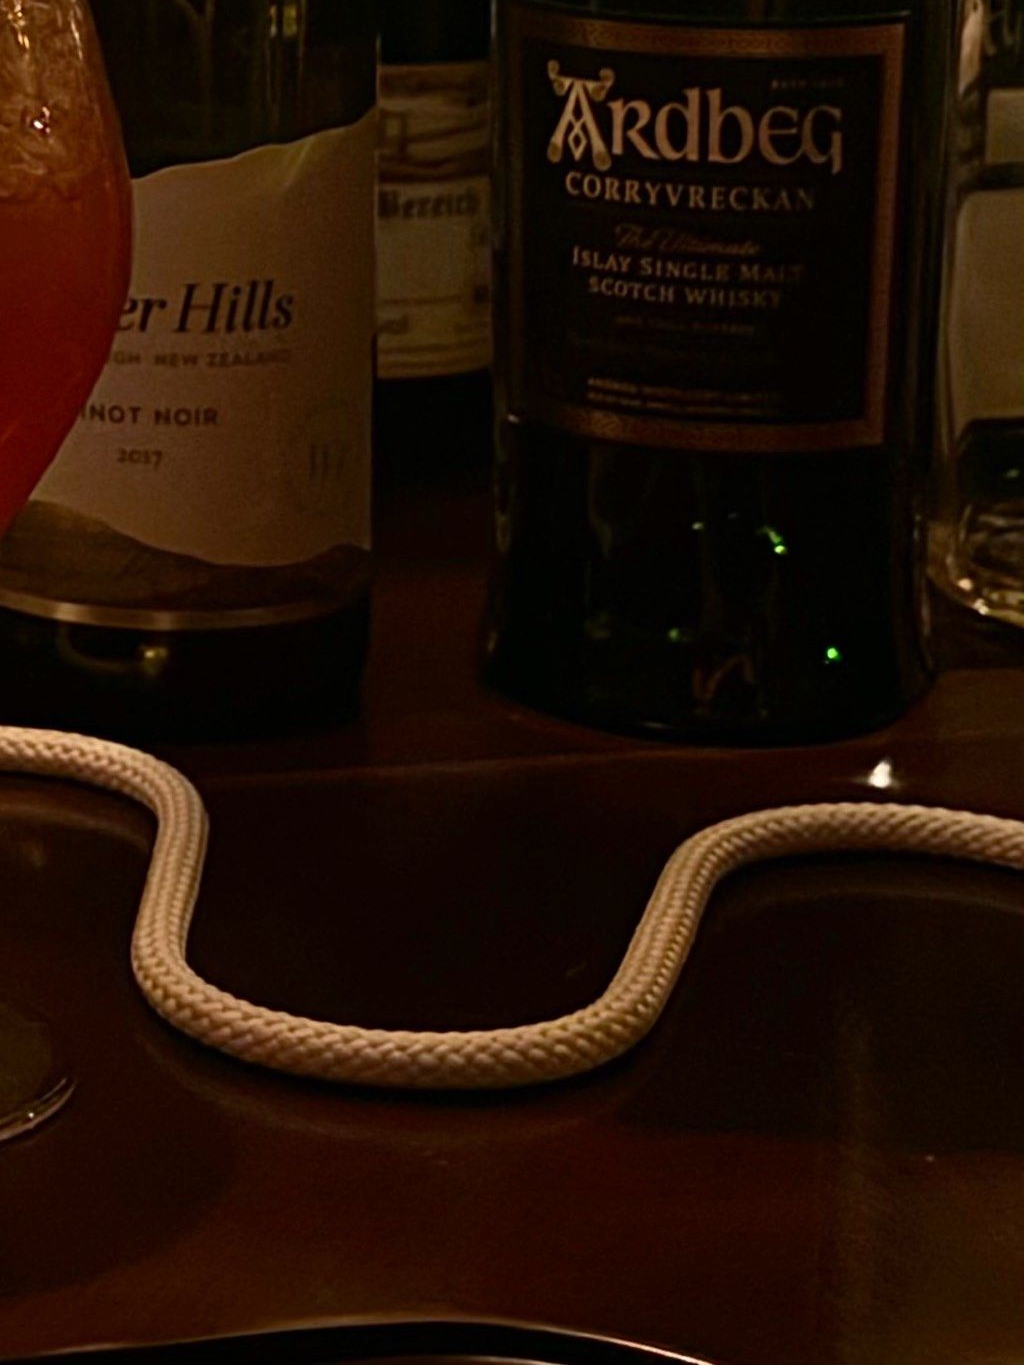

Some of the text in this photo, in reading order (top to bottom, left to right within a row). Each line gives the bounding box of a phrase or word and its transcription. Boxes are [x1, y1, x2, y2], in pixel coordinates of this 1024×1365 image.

[565, 171, 815, 211] CORRYVRECKAN
[589, 275, 675, 304] SCOTCH
[175, 280, 294, 333] Hills
[154, 352, 198, 368] NEW
[154, 407, 219, 426] NOIR
[117, 449, 163, 469] 2017
